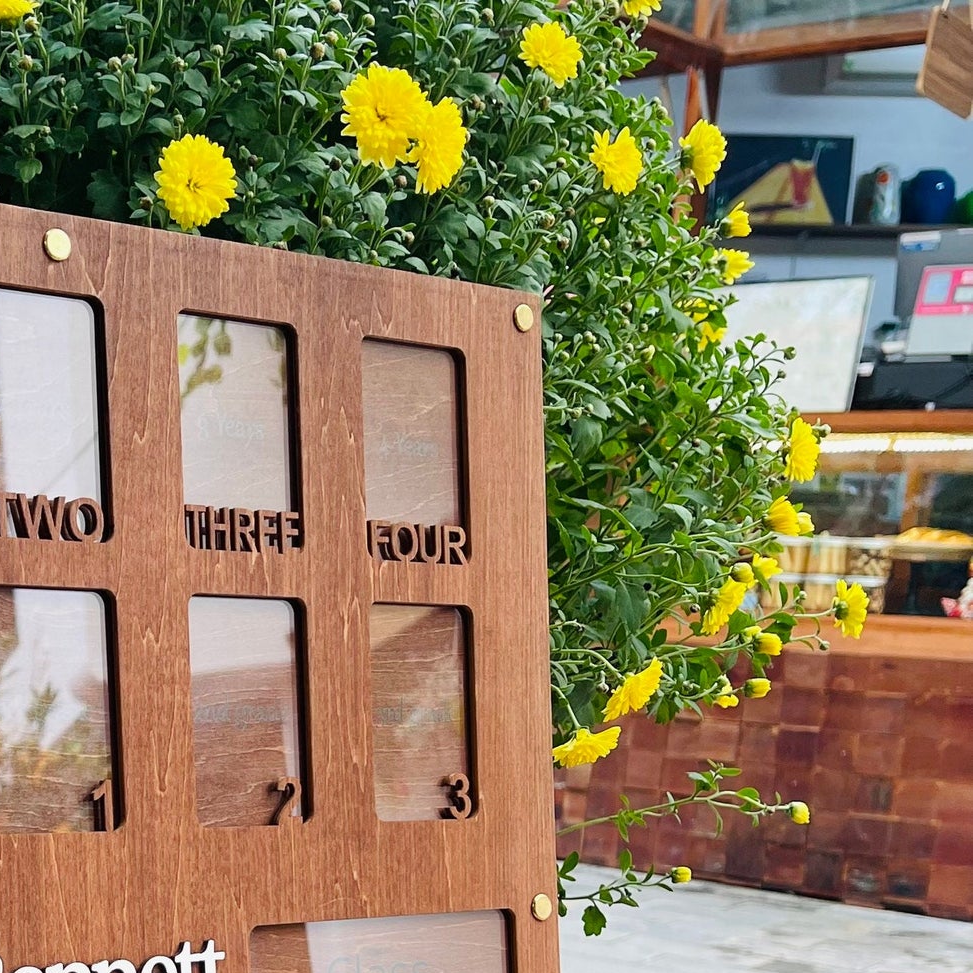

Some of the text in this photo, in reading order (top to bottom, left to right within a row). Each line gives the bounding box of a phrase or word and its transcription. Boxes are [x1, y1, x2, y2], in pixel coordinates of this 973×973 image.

[185, 503, 301, 554] THREE
[367, 518, 468, 565] FOUR
[84, 779, 115, 832] 1
[269, 776, 303, 826] 2
[438, 772, 473, 820] 3
